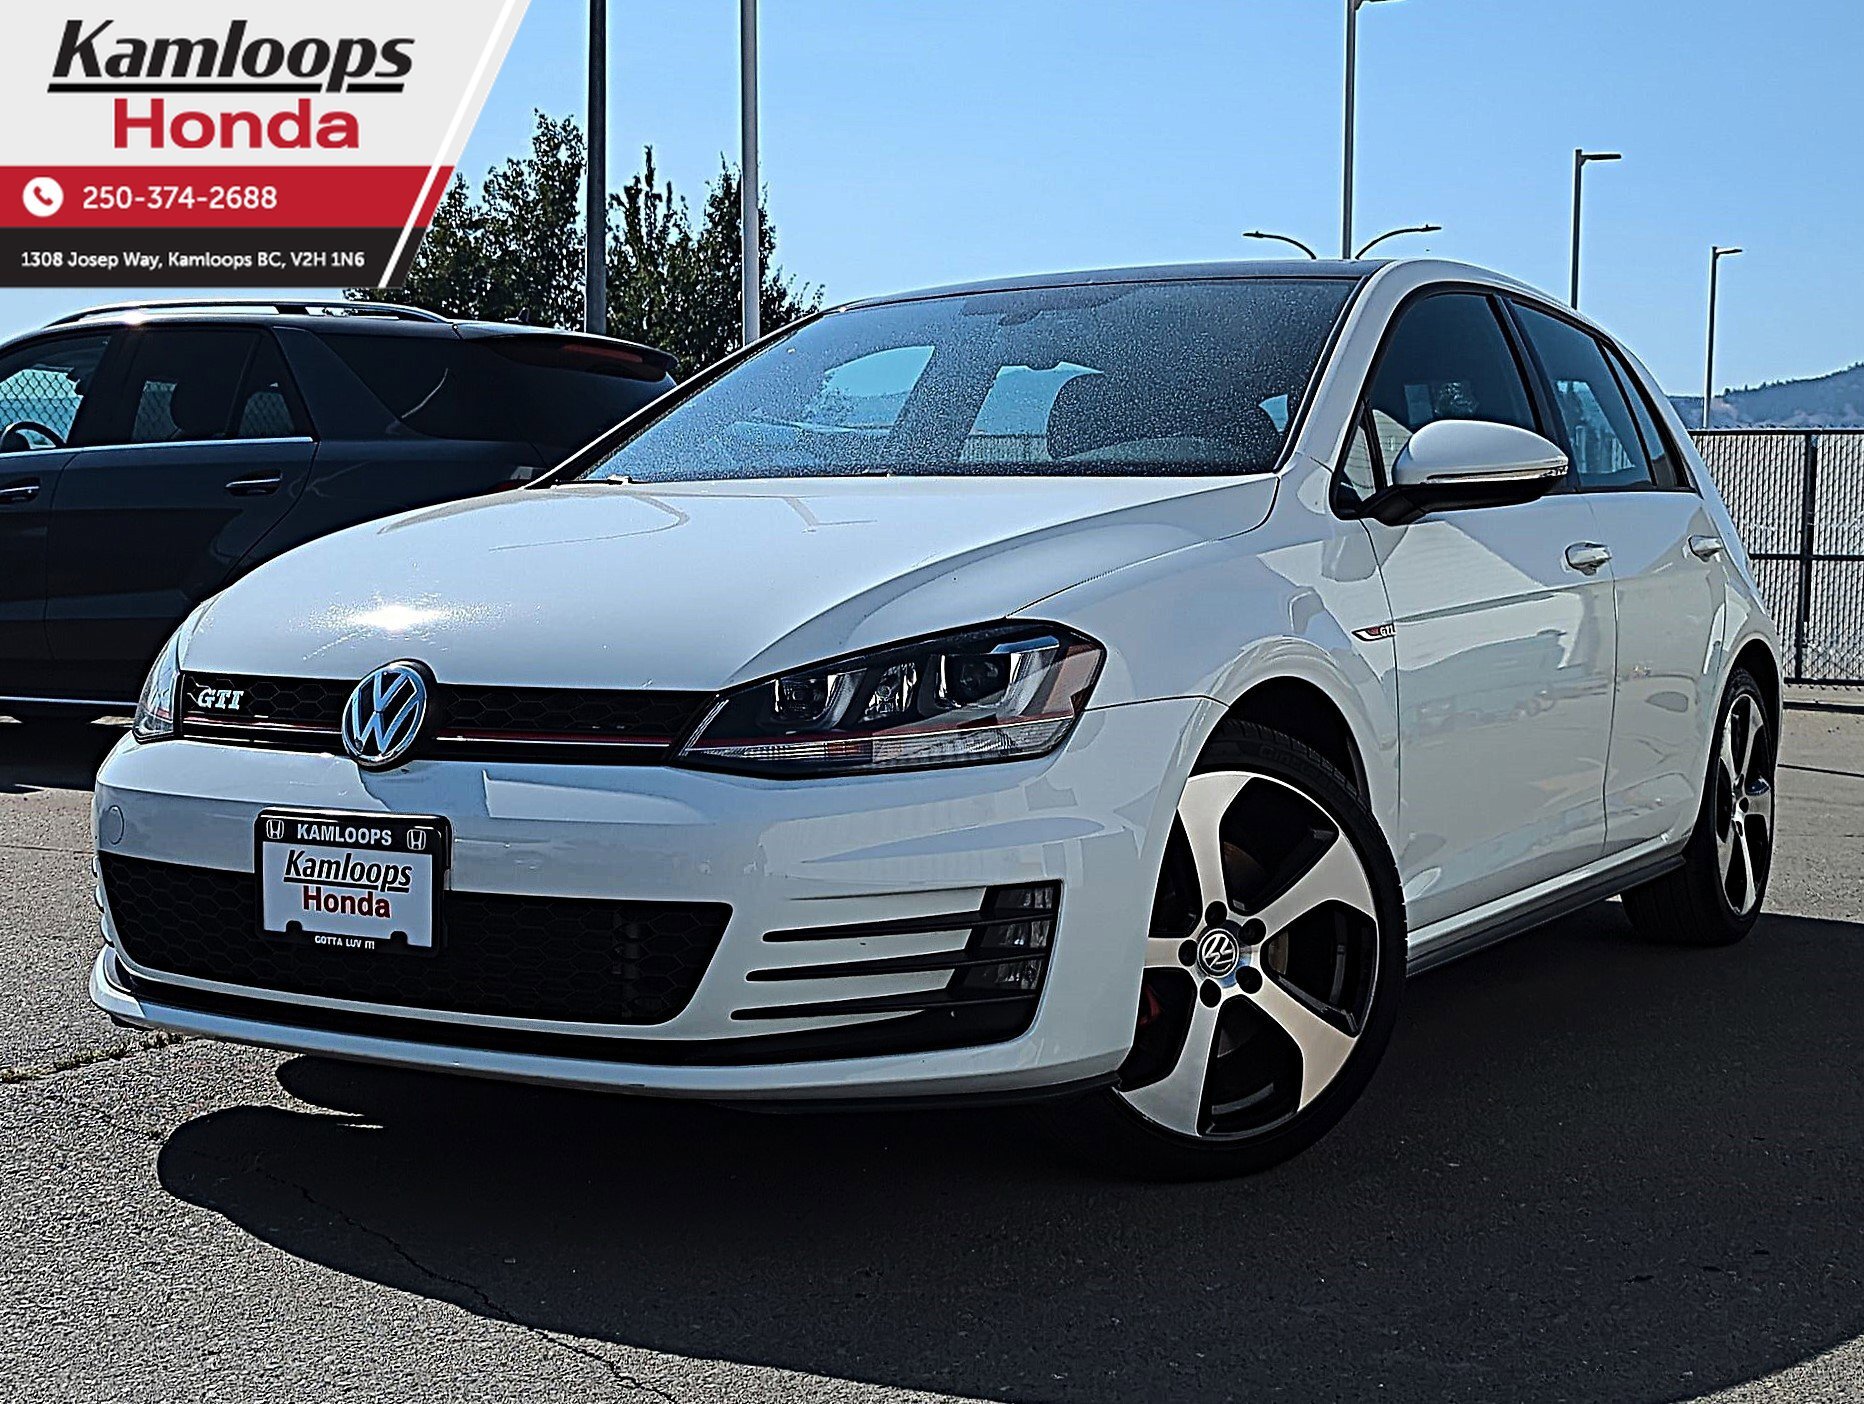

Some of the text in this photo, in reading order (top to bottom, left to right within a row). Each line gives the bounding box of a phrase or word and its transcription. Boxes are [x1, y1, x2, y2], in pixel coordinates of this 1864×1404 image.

[197, 689, 244, 710] GTI
[297, 823, 392, 846] KAMLOOPS
[285, 848, 413, 893] Kamloops
[303, 885, 392, 919] Honda
[314, 935, 343, 946] GOTTA
[345, 938, 362, 948] LUV
